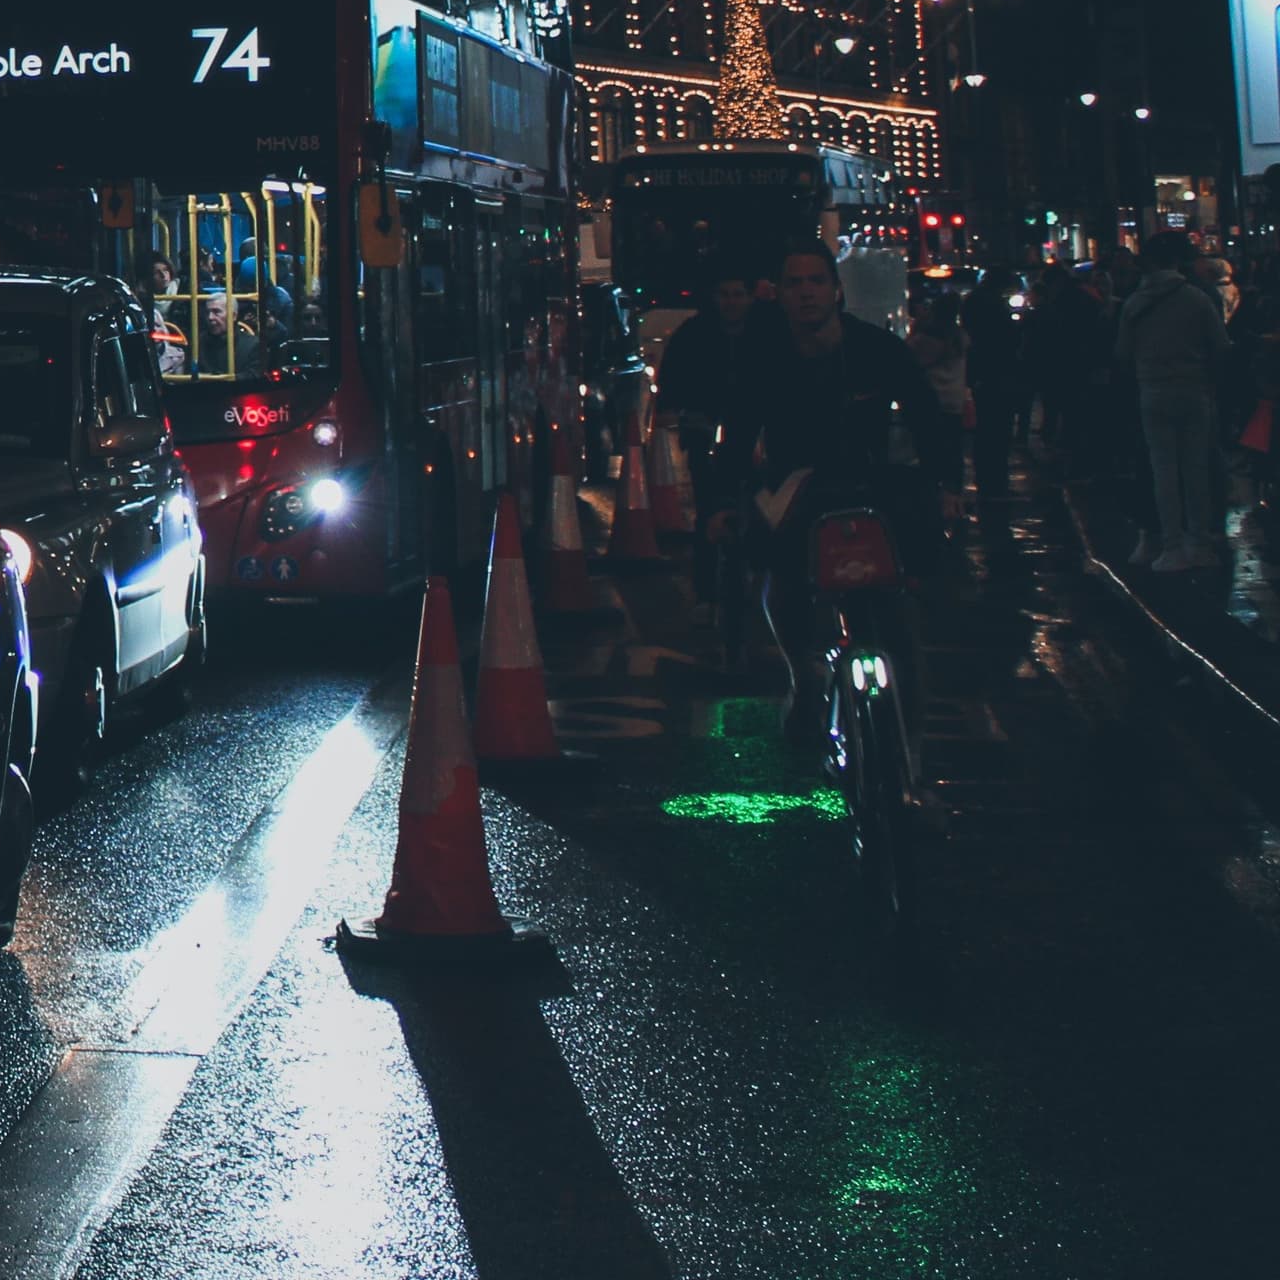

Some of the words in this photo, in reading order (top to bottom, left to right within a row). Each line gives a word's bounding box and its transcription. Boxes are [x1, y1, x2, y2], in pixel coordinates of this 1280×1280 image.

[53, 42, 131, 76] Arch
[191, 26, 271, 84] 74
[256, 134, 321, 153] MHV88
